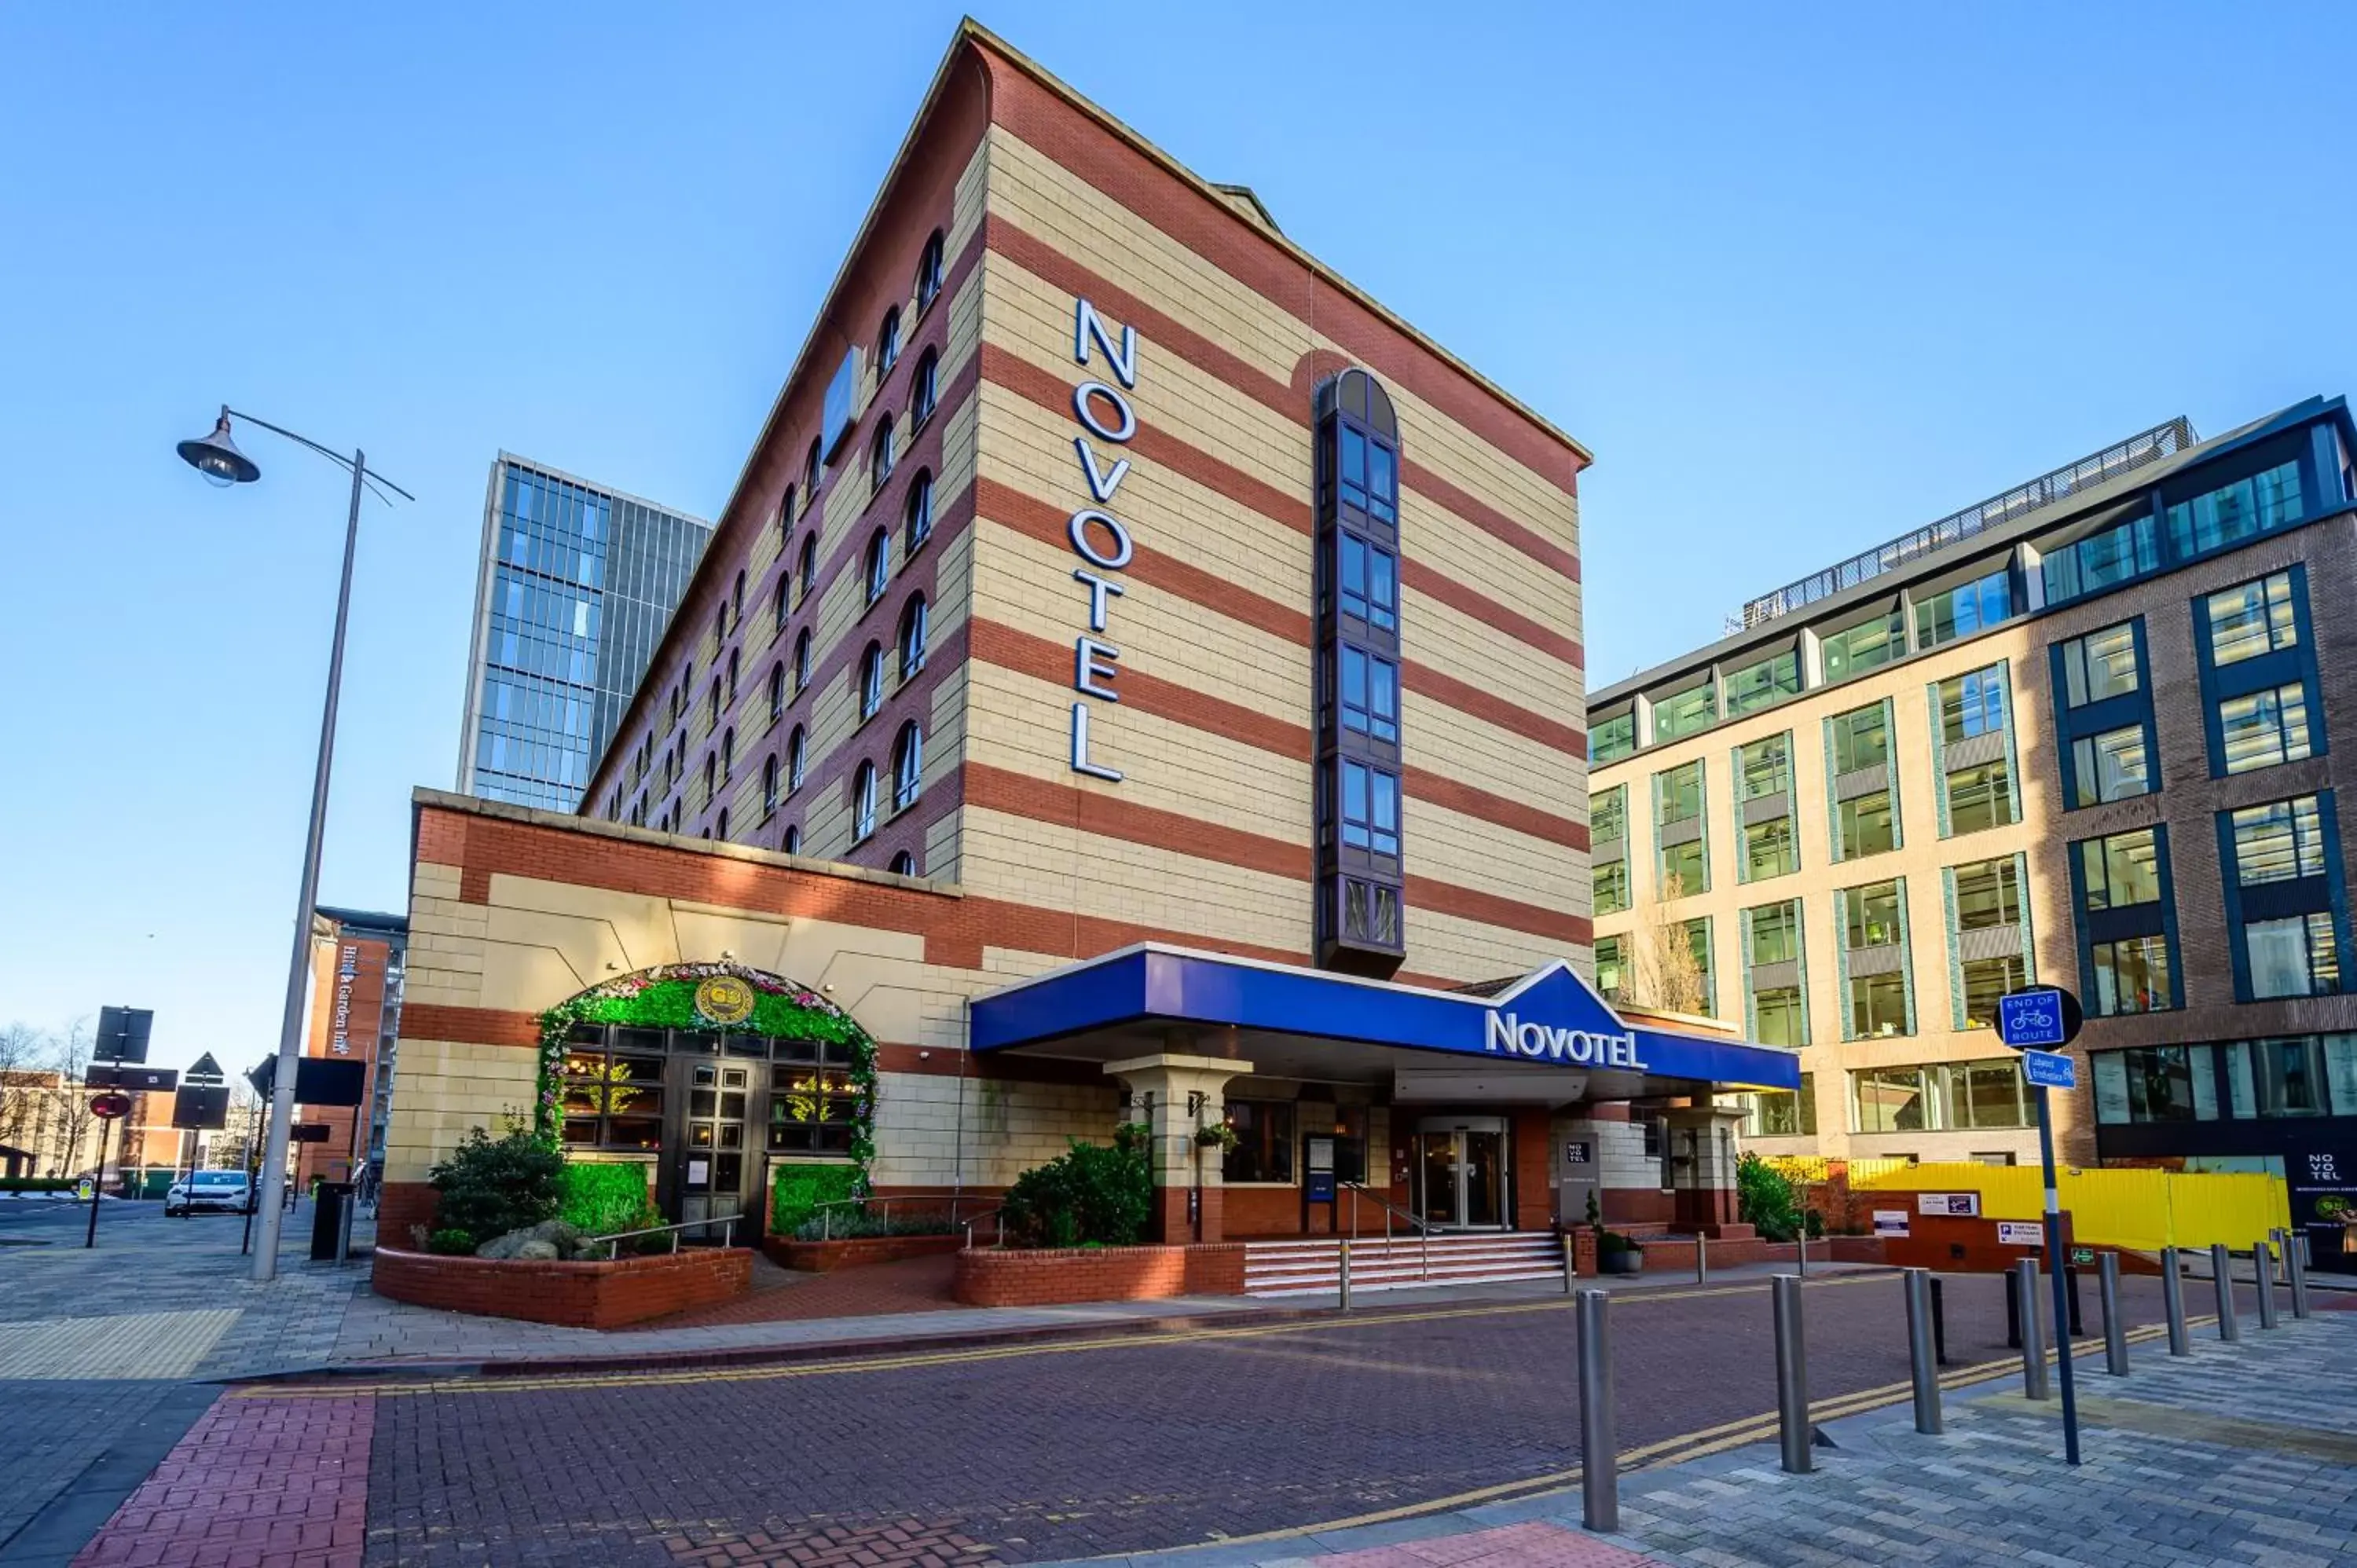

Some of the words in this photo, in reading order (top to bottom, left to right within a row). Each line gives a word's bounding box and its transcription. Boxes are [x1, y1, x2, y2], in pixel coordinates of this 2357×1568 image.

[1068, 297, 1136, 782] NOVOTEL
[335, 986, 353, 1028] Garden
[2007, 998, 2033, 1009] END
[2037, 995, 2055, 1006] OF
[1485, 1009, 1648, 1069] NOVOTEL
[2012, 1030, 2054, 1041] ROUTE
[2310, 1171, 2342, 1181] TEL
